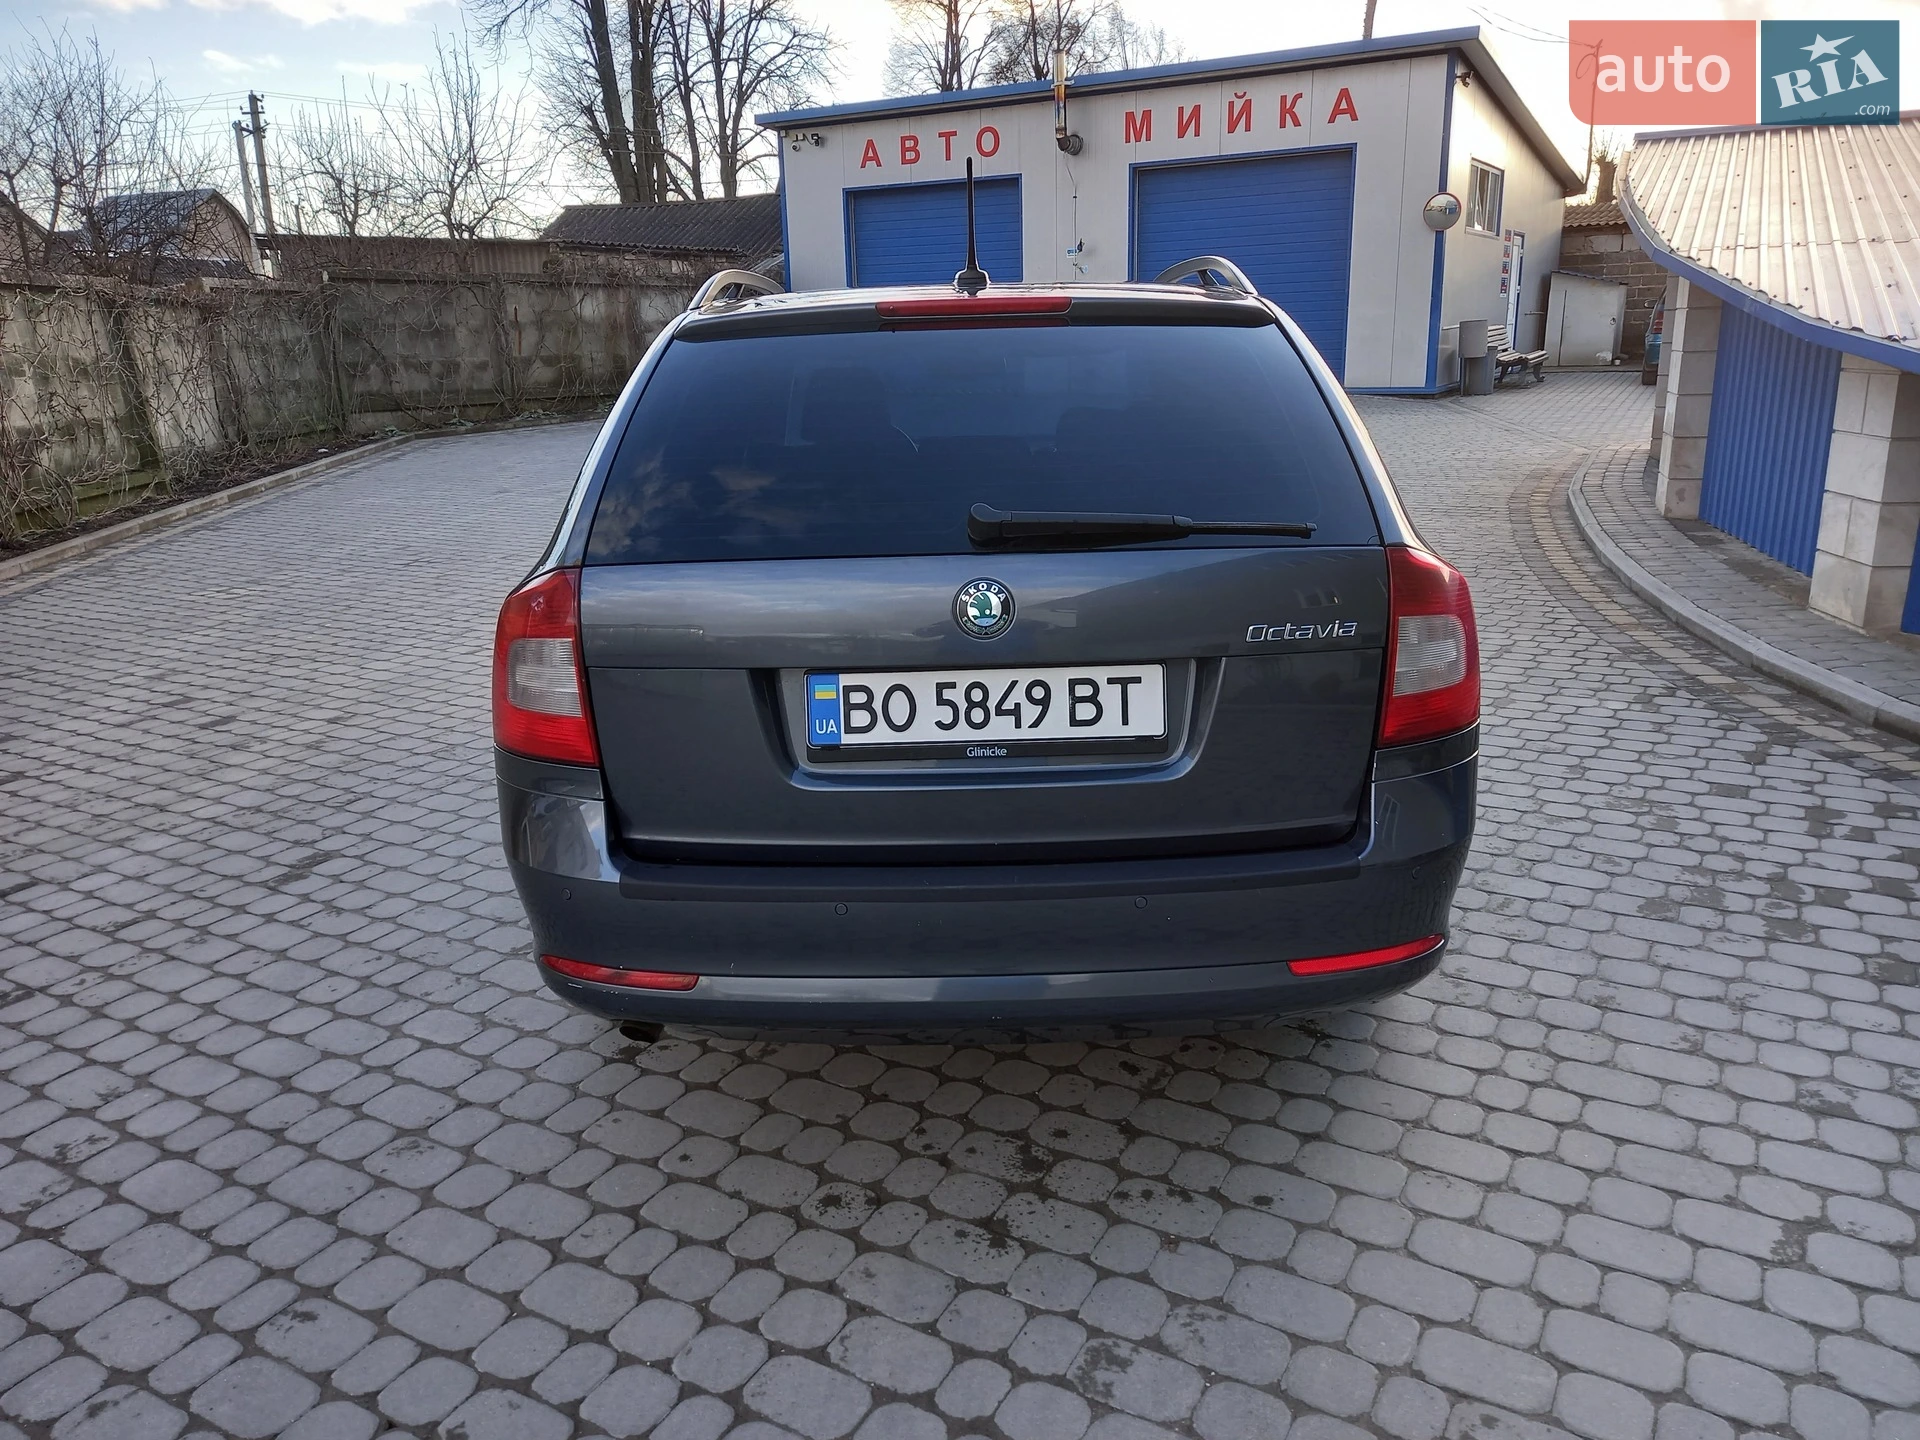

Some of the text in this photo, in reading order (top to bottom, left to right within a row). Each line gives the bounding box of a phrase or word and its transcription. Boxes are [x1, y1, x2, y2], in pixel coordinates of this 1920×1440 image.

[860, 87, 1358, 169] АВТО МИЙКА
[1246, 620, 1357, 642] Octavia
[815, 677, 1142, 735] UA BO 5849 BT
[966, 746, 1007, 757] Glinicke
